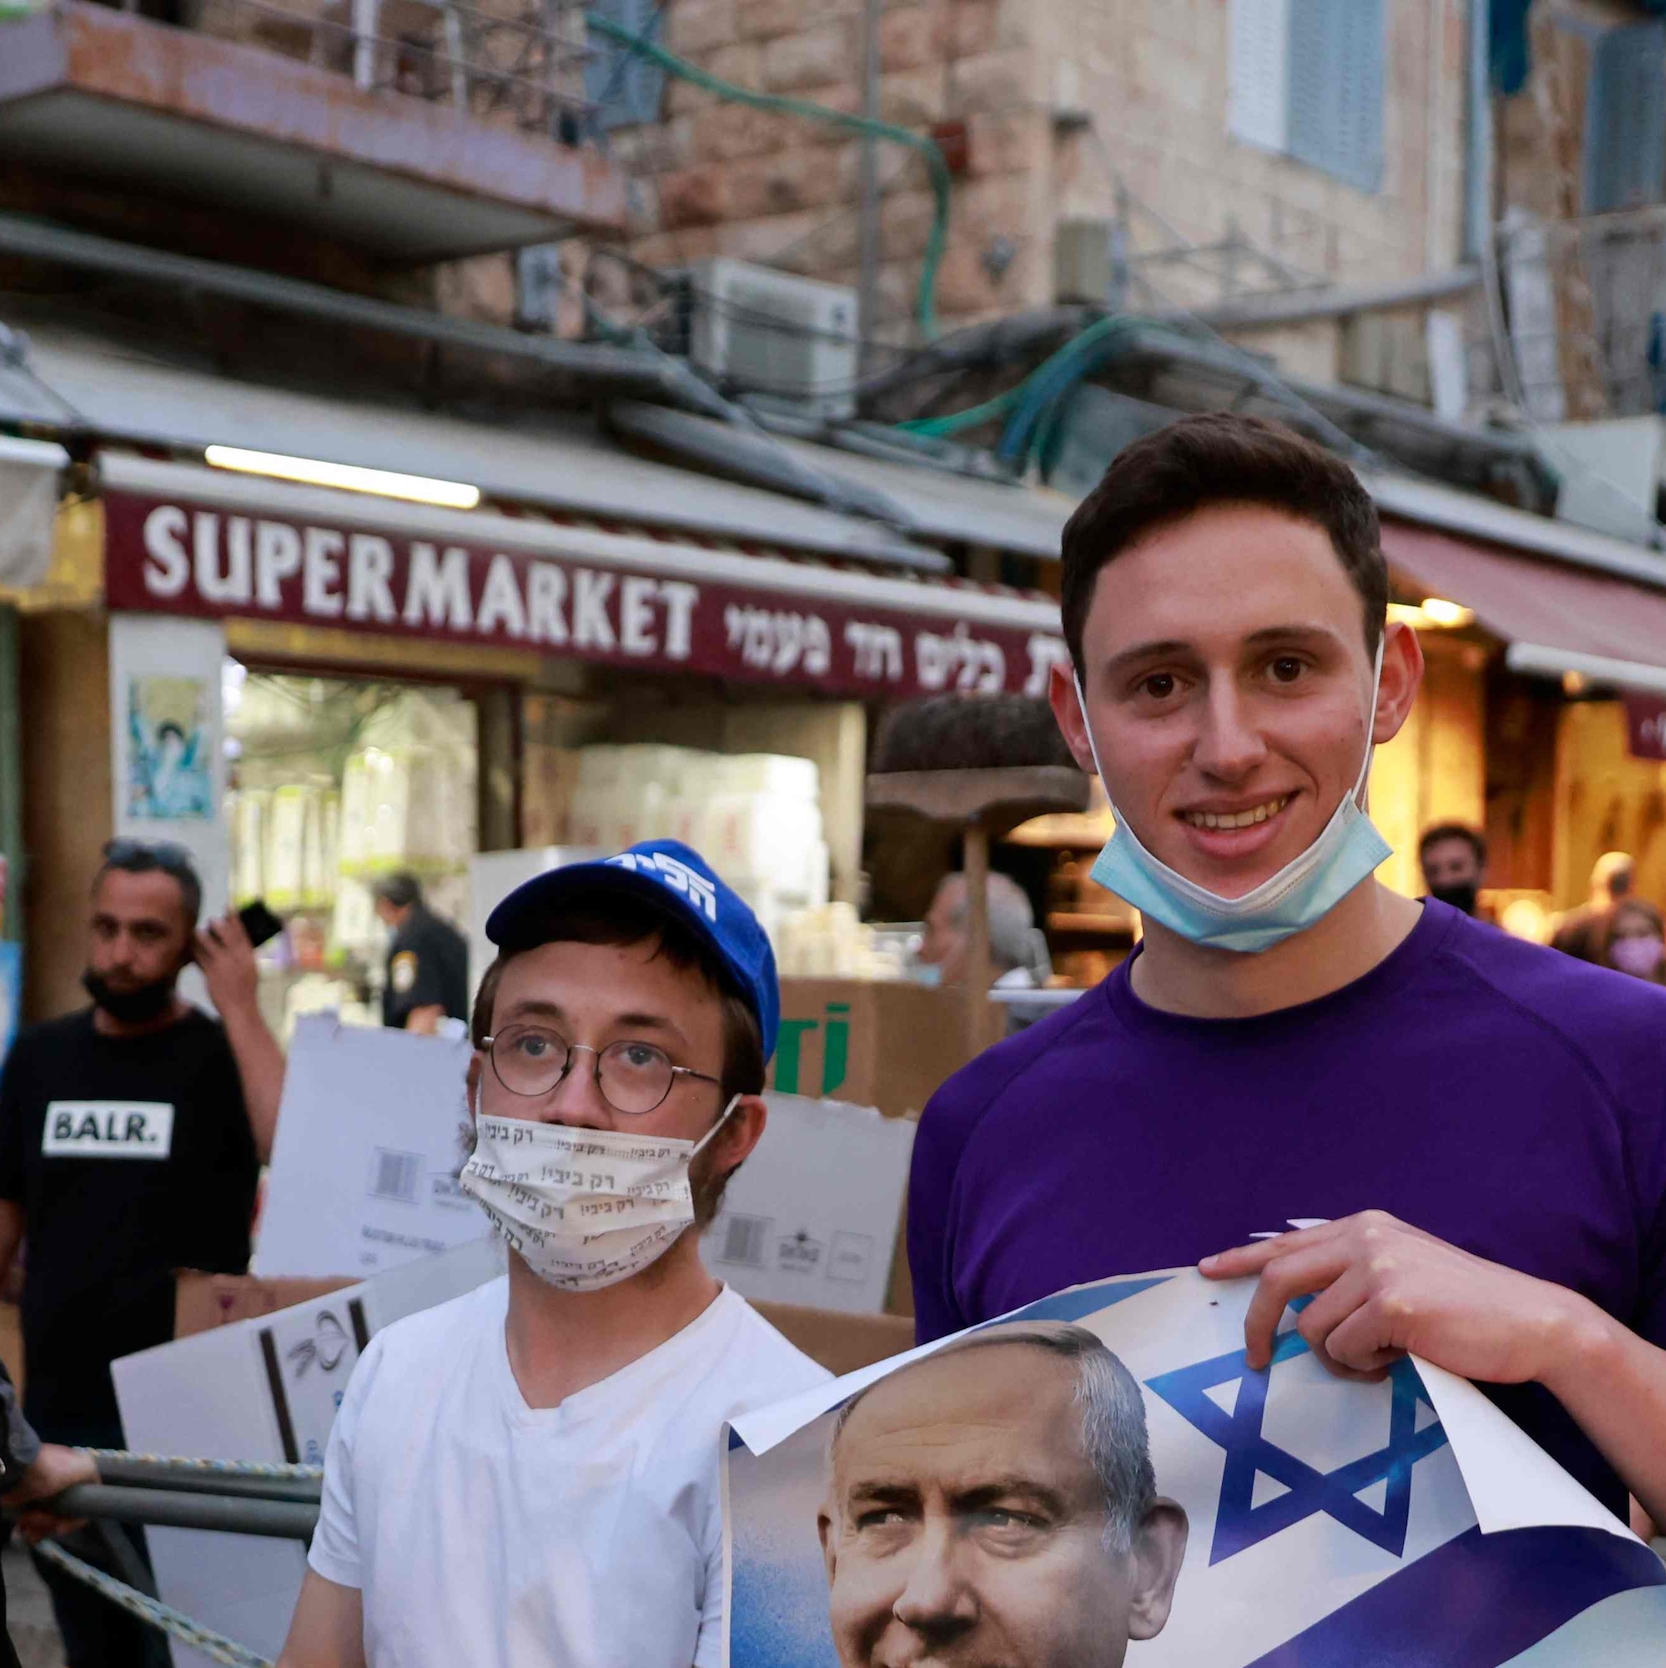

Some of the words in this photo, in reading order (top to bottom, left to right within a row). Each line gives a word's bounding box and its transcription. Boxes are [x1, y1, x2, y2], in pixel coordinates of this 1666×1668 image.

[142, 504, 700, 660] SUPERMARKET
[55, 1112, 158, 1142] BALR.
[513, 1128, 533, 1145] רק
[541, 1165, 583, 1186] ביבי!
[590, 1174, 615, 1190] רק
[541, 1202, 565, 1220] רק
